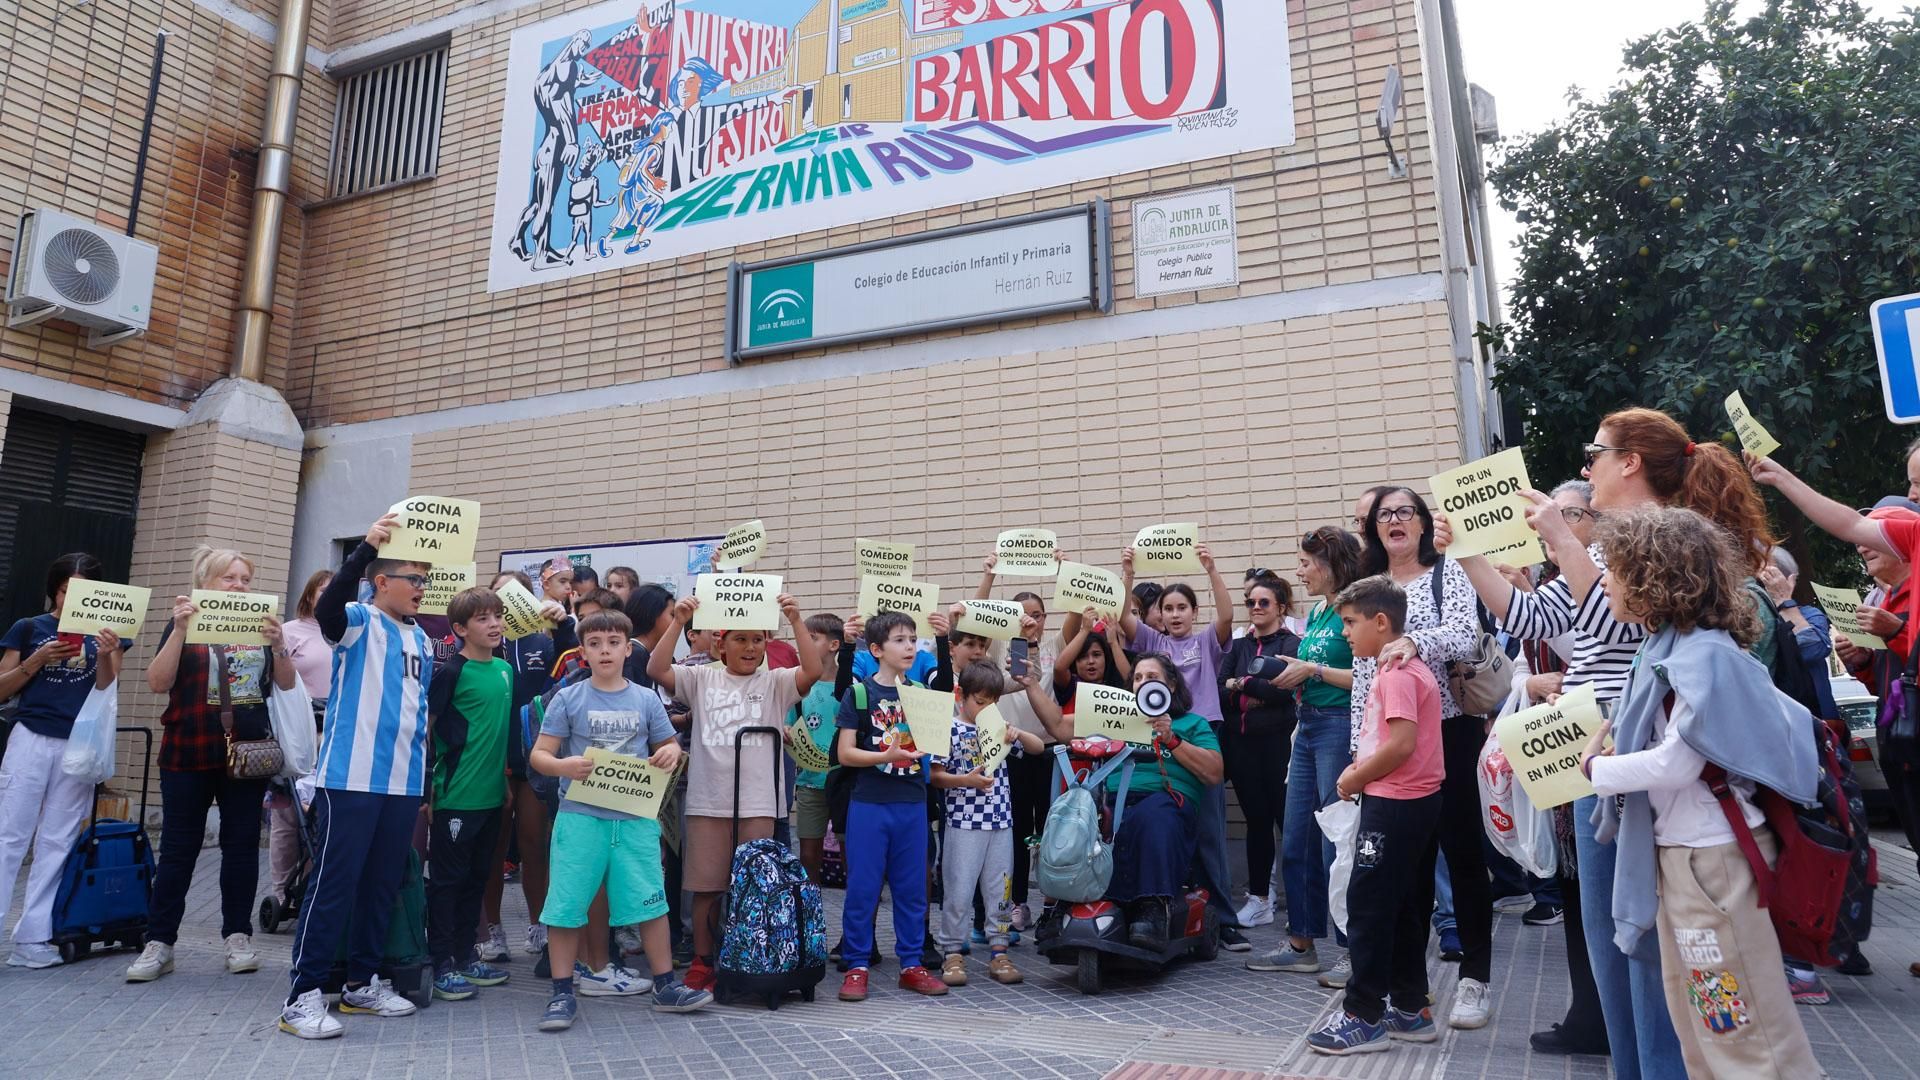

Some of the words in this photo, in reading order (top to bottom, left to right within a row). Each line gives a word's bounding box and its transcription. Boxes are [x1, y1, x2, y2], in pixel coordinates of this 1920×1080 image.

[610, 24, 638, 45] POR
[649, 1, 673, 27] UNA
[669, 9, 786, 86] NUESTRA
[914, 0, 1197, 121] BARRIO
[606, 88, 625, 101] AL
[605, 125, 650, 147] APREN
[607, 144, 632, 162] DER
[1169, 206, 1203, 224] JUNTA
[1209, 204, 1222, 217] DE
[854, 274, 893, 290] Colegio
[896, 270, 908, 282] de
[911, 260, 968, 280] Educación
[970, 253, 1010, 270] Infantil
[1012, 253, 1018, 266] y
[1022, 243, 1072, 261] Primaria
[1158, 256, 1182, 268] Colegio
[995, 272, 1042, 295] Hernán
[1046, 269, 1073, 288] Ruiz
[1456, 474, 1476, 488] POR
[1478, 468, 1492, 480] UN
[1444, 476, 1522, 514] COMEDOR
[406, 502, 462, 518] COCINA
[406, 518, 460, 534] PROPIA
[1463, 506, 1514, 532] DIGNO
[414, 537, 442, 551] ¡YA!
[718, 532, 762, 550] OMEDOR
[1000, 540, 1054, 548] COMEDOR
[1138, 538, 1192, 546] COMEDOR
[728, 545, 756, 560] DIGNO
[860, 548, 908, 561] COMEDOR
[1147, 552, 1182, 560] DIGNO
[873, 562, 907, 570] PRODUCTOS
[426, 572, 466, 582] MEDOR
[714, 578, 764, 588] COCINA
[877, 583, 922, 598] COCINA
[1070, 578, 1114, 595] COCINA
[716, 592, 764, 602] PROPIA
[1086, 595, 1117, 607] COLEGIO
[82, 598, 133, 612] COCINA
[200, 600, 270, 613] COMEDOR
[724, 608, 748, 617] ¡YA!
[878, 598, 921, 612] PROPIA
[966, 601, 1018, 616] COMEDOR
[100, 615, 136, 624] COLEGIO
[975, 613, 1008, 627] DIGNO
[197, 623, 212, 632] DE
[401, 652, 422, 682] 10
[704, 688, 742, 711] SEA
[708, 702, 746, 730] YOU
[1094, 704, 1138, 717] PROPIA
[1102, 719, 1125, 730] ¡YA!
[1524, 720, 1544, 733] POR
[1544, 710, 1564, 726] UNA
[1522, 722, 1587, 758] COCINA
[595, 766, 651, 785] COCINA
[1527, 770, 1543, 782] EN
[1544, 762, 1558, 776] MI
[612, 785, 654, 799] COLEGIO
[1674, 928, 1718, 945] SUPER
[1680, 946, 1723, 964] MARIO
